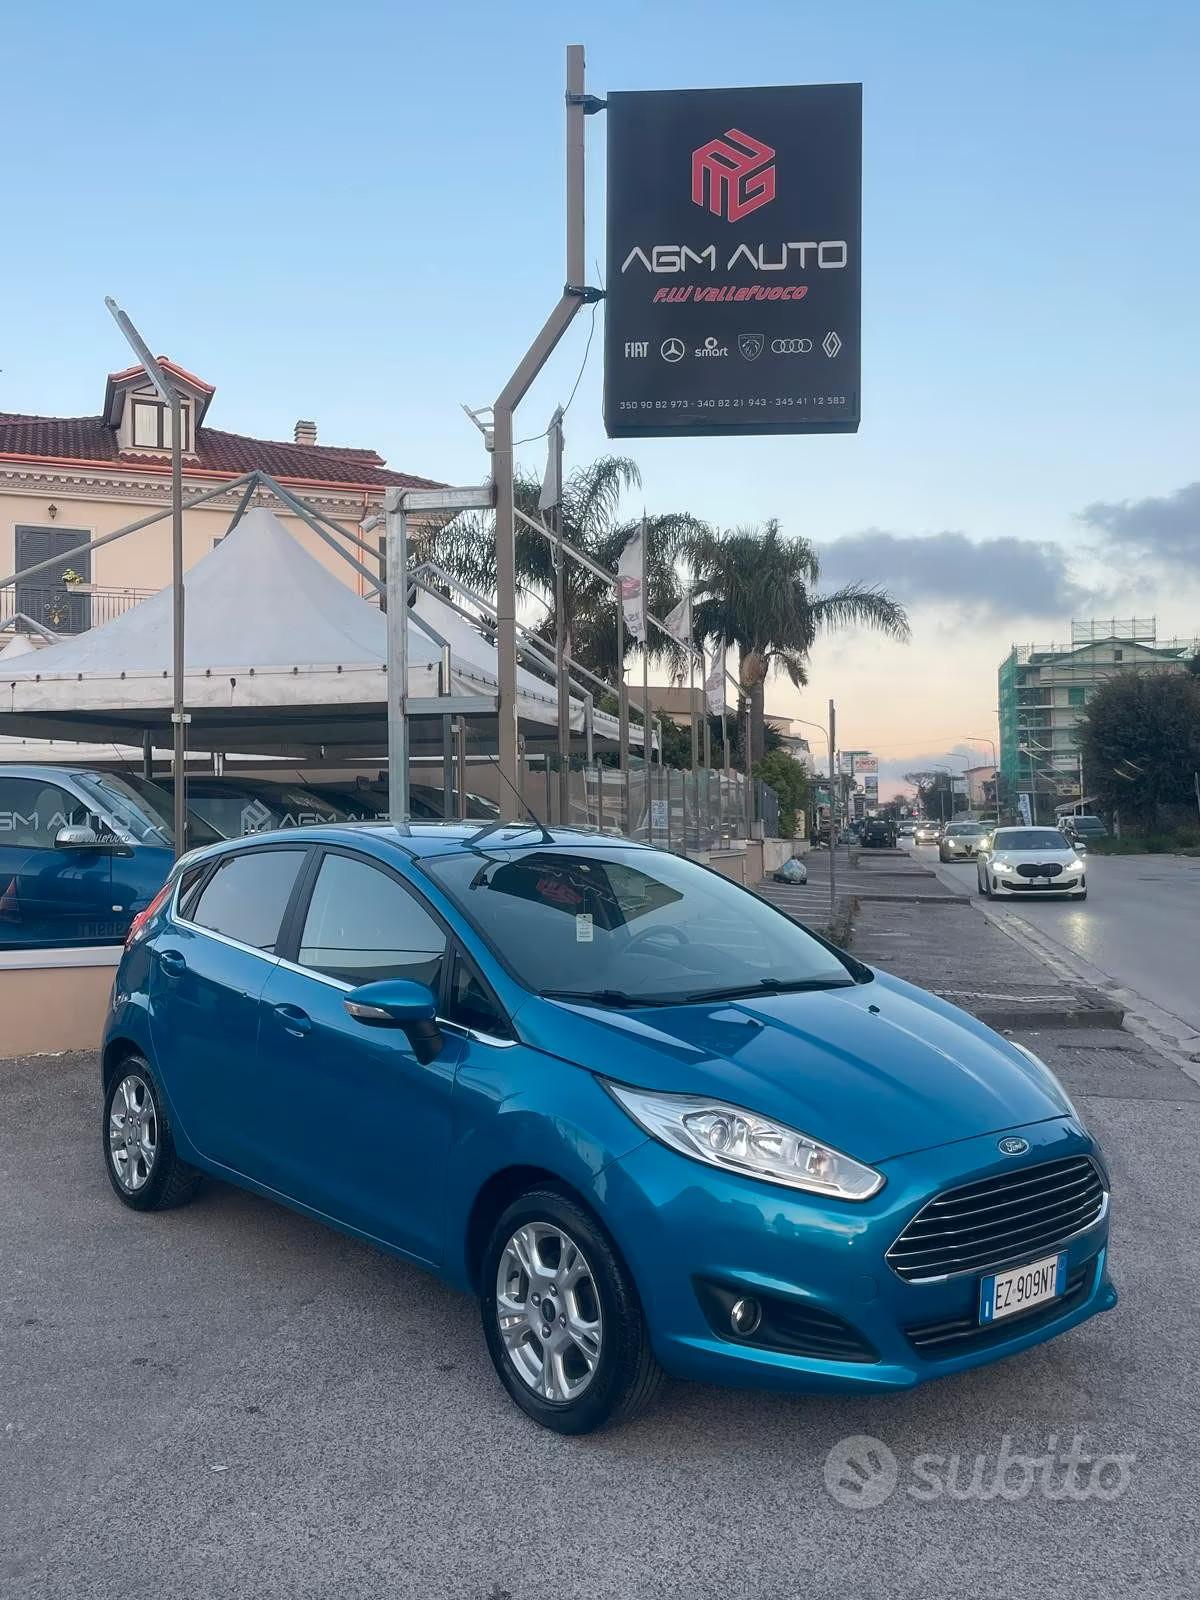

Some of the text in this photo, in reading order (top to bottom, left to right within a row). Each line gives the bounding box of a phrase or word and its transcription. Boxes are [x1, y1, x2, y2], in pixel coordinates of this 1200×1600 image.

[621, 240, 848, 273] AGM AUTO
[624, 341, 729, 359] FIAT smart
[619, 401, 638, 410] 350
[640, 401, 653, 409] 90
[655, 401, 668, 409] 82
[670, 400, 689, 409] 973
[697, 399, 716, 408] 340
[718, 399, 731, 408] 82
[733, 399, 745, 407] 21
[748, 398, 767, 407] 943
[775, 397, 794, 406] 345
[796, 397, 809, 406] 41
[812, 396, 825, 405] 12
[826, 396, 846, 405] 583
[0, 811, 39, 831] GM
